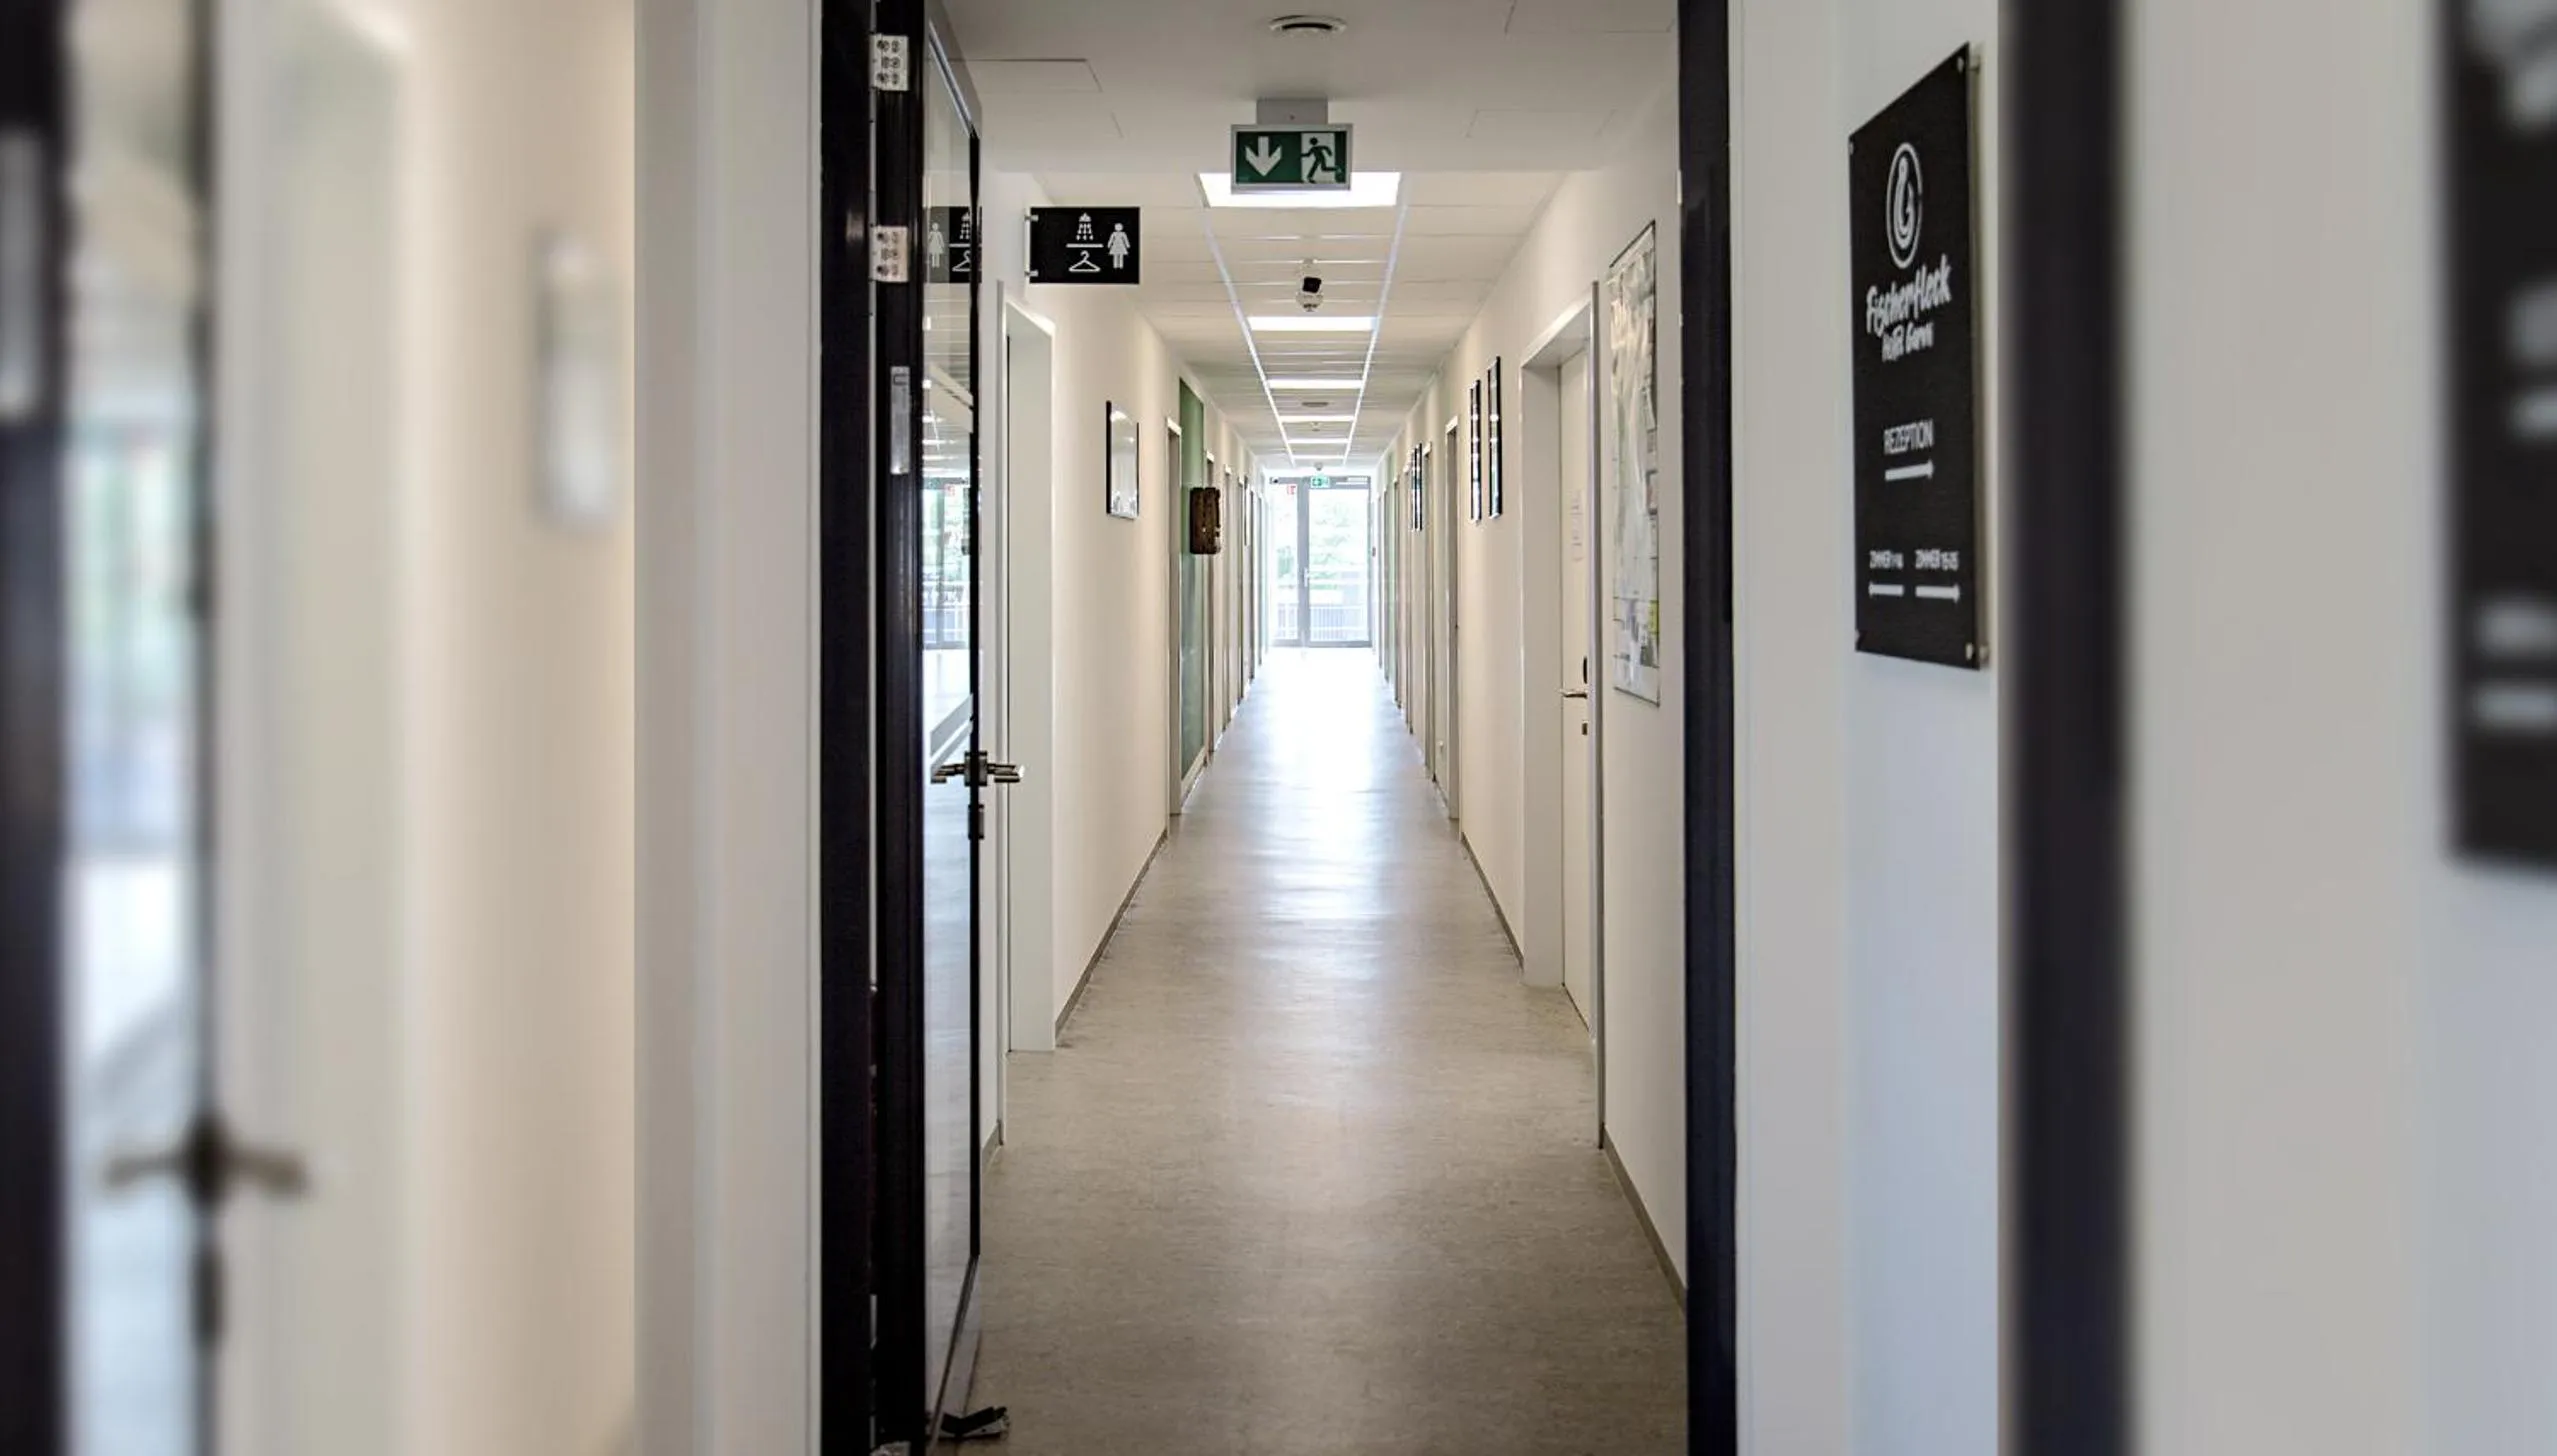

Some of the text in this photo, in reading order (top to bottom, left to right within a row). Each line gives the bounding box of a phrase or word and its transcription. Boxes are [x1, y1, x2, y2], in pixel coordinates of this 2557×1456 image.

[1884, 418, 1934, 455] REZEPTION
[1869, 550, 1891, 569] ZIMMER
[1915, 548, 1940, 569] ZIMMER
